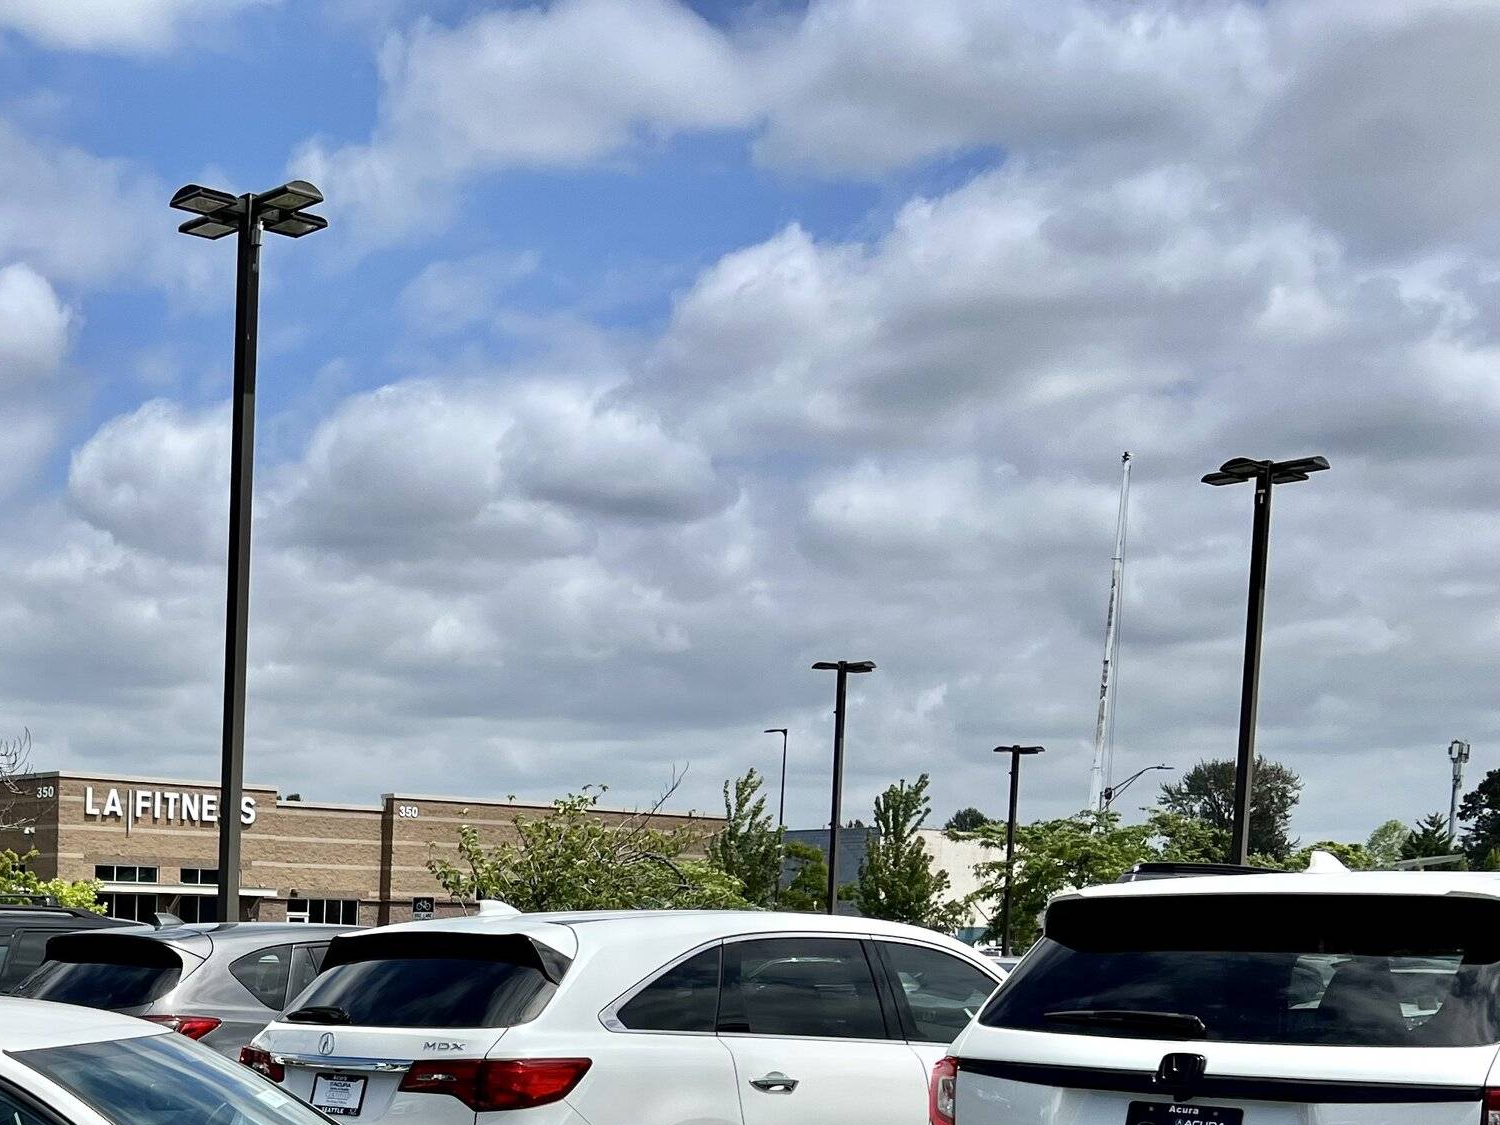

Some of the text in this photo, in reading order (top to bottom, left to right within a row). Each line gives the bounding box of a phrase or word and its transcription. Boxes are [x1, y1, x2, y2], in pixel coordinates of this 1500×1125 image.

[36, 786, 54, 799] 350
[85, 786, 257, 825] LA FITNES
[399, 805, 419, 818] 350
[422, 1041, 467, 1051] MDX
[1169, 1105, 1199, 1115] Acura
